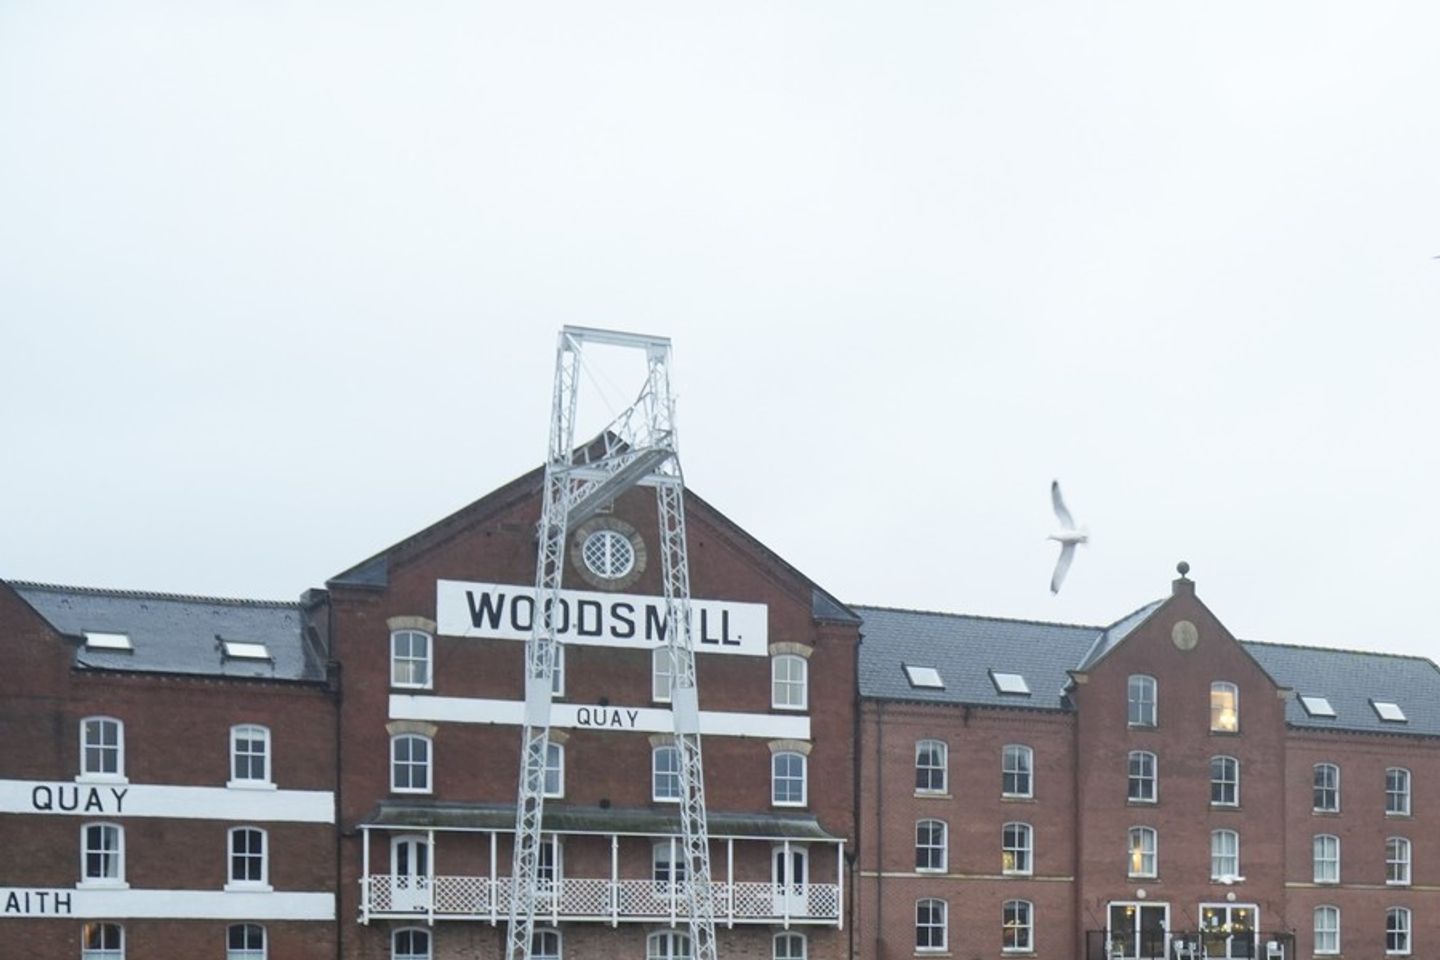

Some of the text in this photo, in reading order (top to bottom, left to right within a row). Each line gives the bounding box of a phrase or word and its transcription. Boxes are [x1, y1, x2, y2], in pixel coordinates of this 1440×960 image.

[464, 590, 742, 647] WOODSMILL
[576, 706, 640, 728] QUAY
[32, 785, 129, 813] QUAY
[4, 891, 73, 915] AITH
